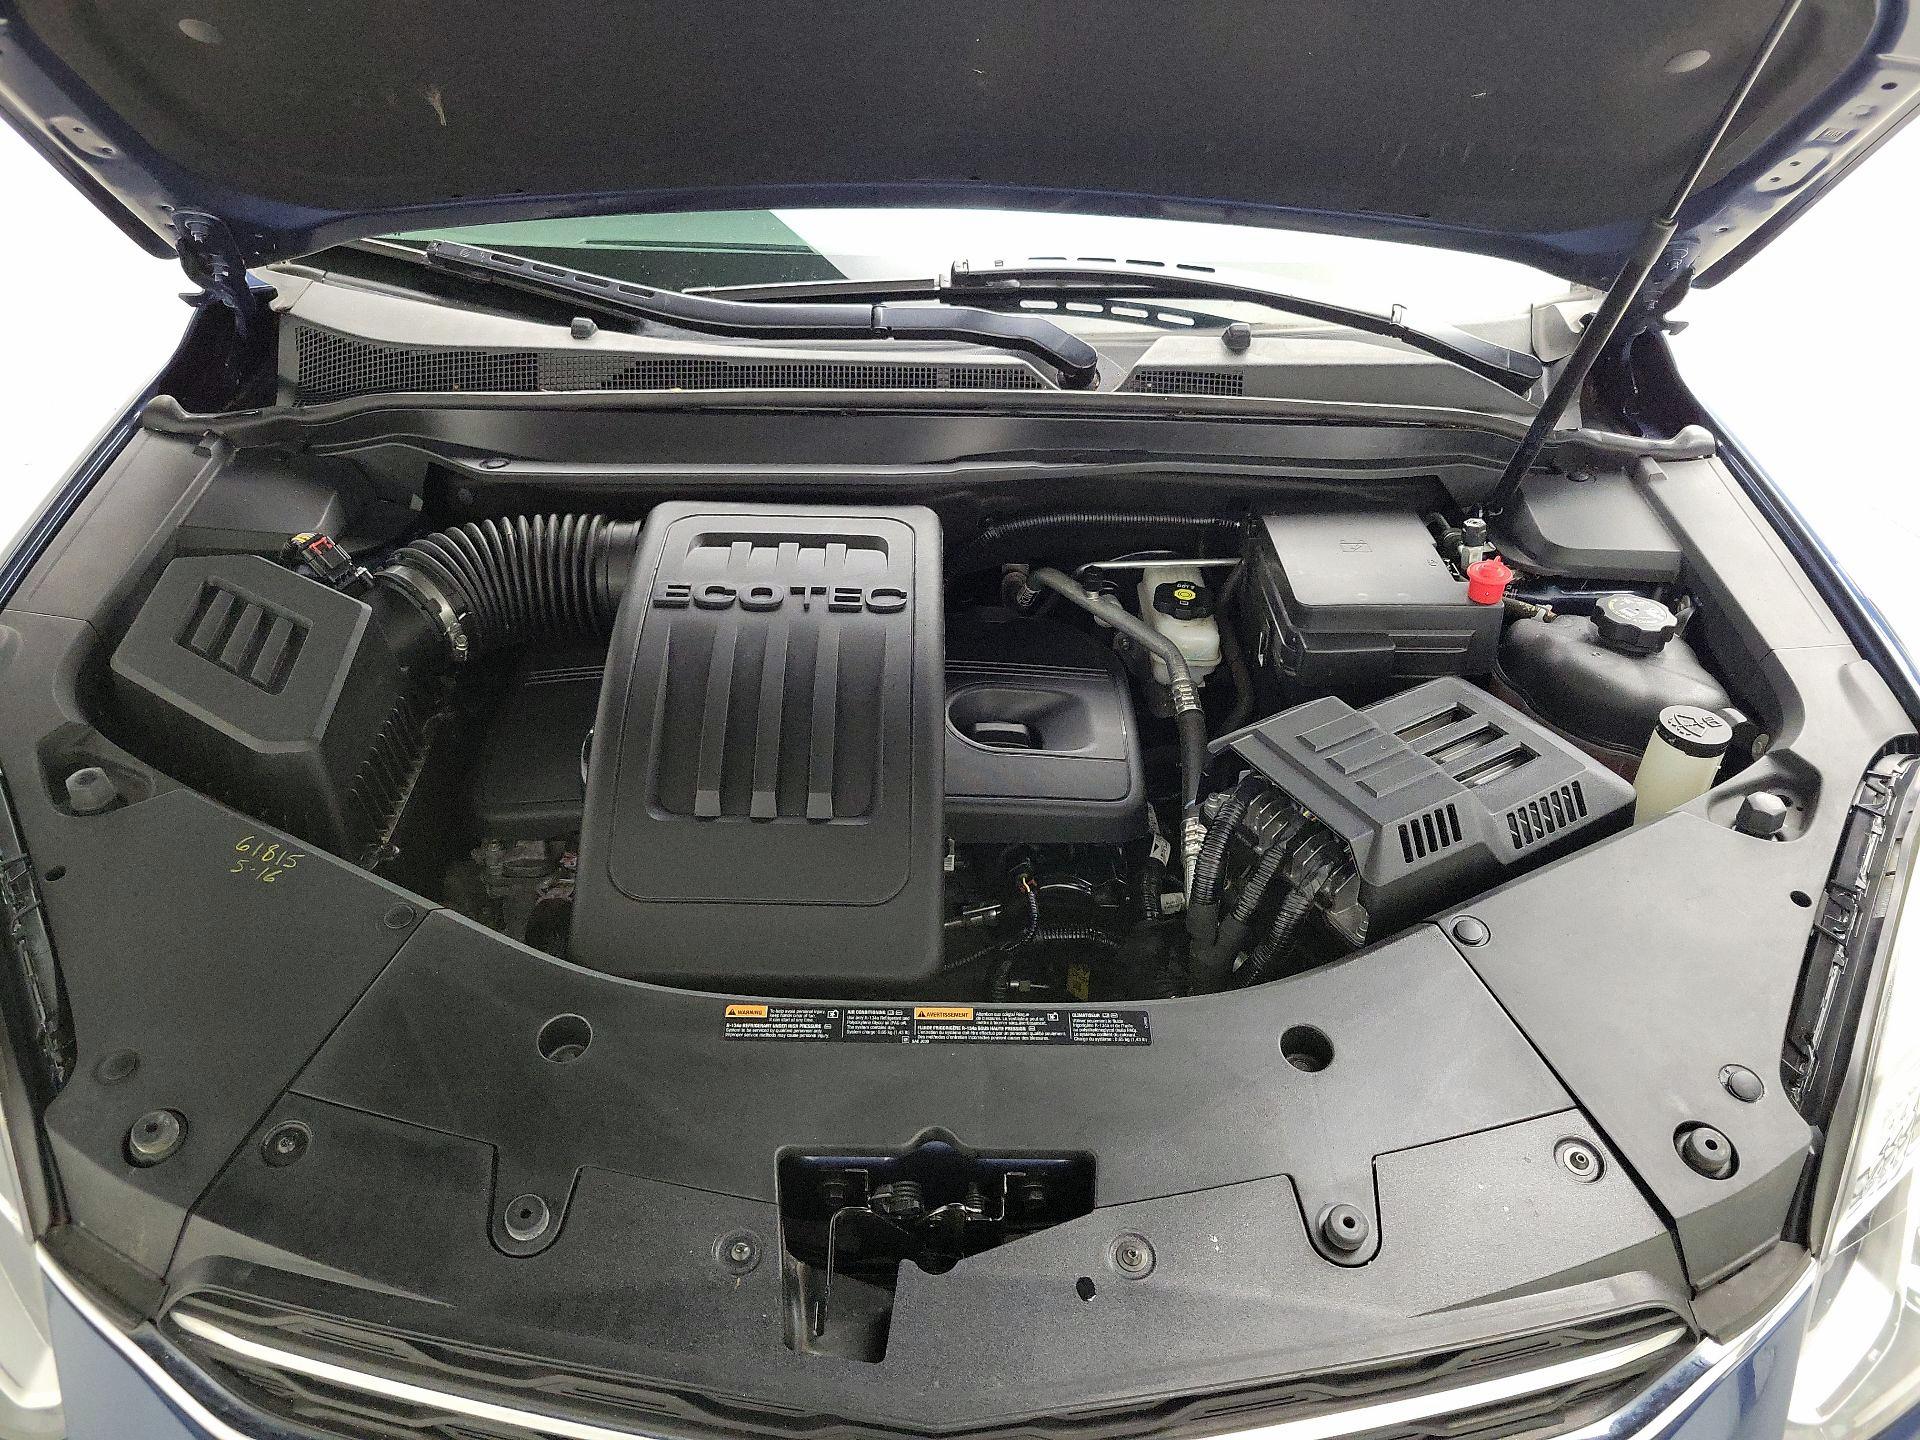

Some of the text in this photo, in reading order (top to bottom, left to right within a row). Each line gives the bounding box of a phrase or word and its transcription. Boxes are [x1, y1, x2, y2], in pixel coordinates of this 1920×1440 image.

[653, 582, 908, 613] ECOTEC
[235, 836, 305, 868] 61815
[230, 859, 282, 882] 5-16
